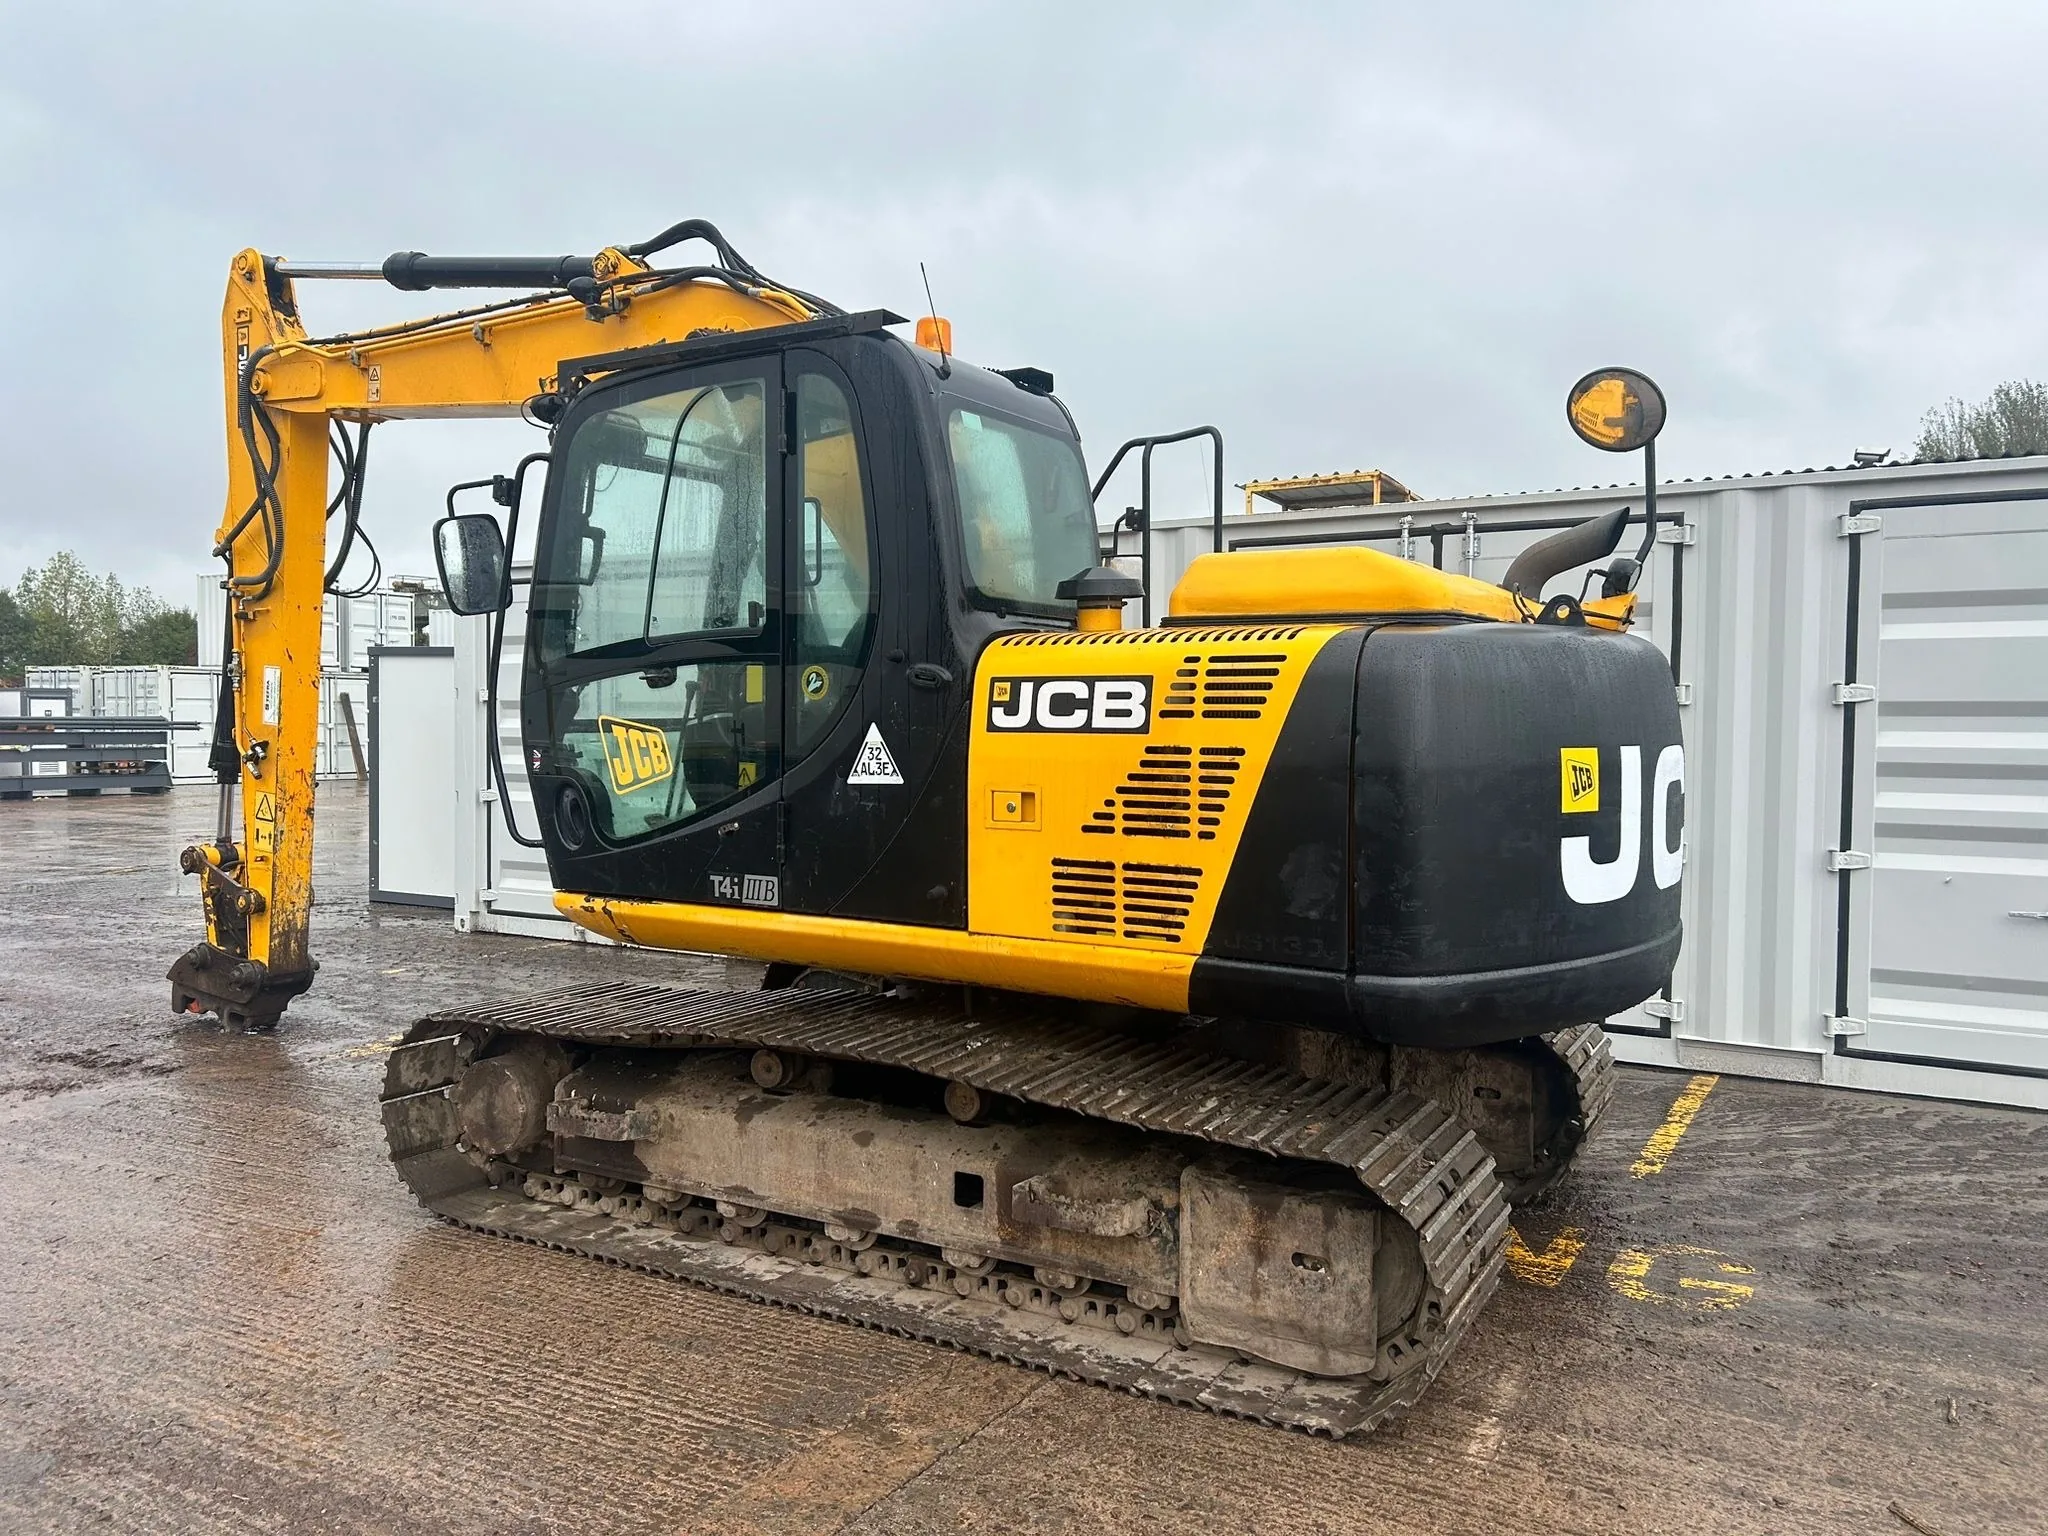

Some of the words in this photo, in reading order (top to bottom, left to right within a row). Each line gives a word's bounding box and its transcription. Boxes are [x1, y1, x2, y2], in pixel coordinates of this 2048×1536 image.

[991, 680, 1148, 729] JCB
[611, 724, 667, 785] JCB
[867, 746, 882, 761] 32
[860, 762, 890, 776] AL3E
[1571, 764, 1593, 798] JCB
[709, 874, 741, 899] T4i
